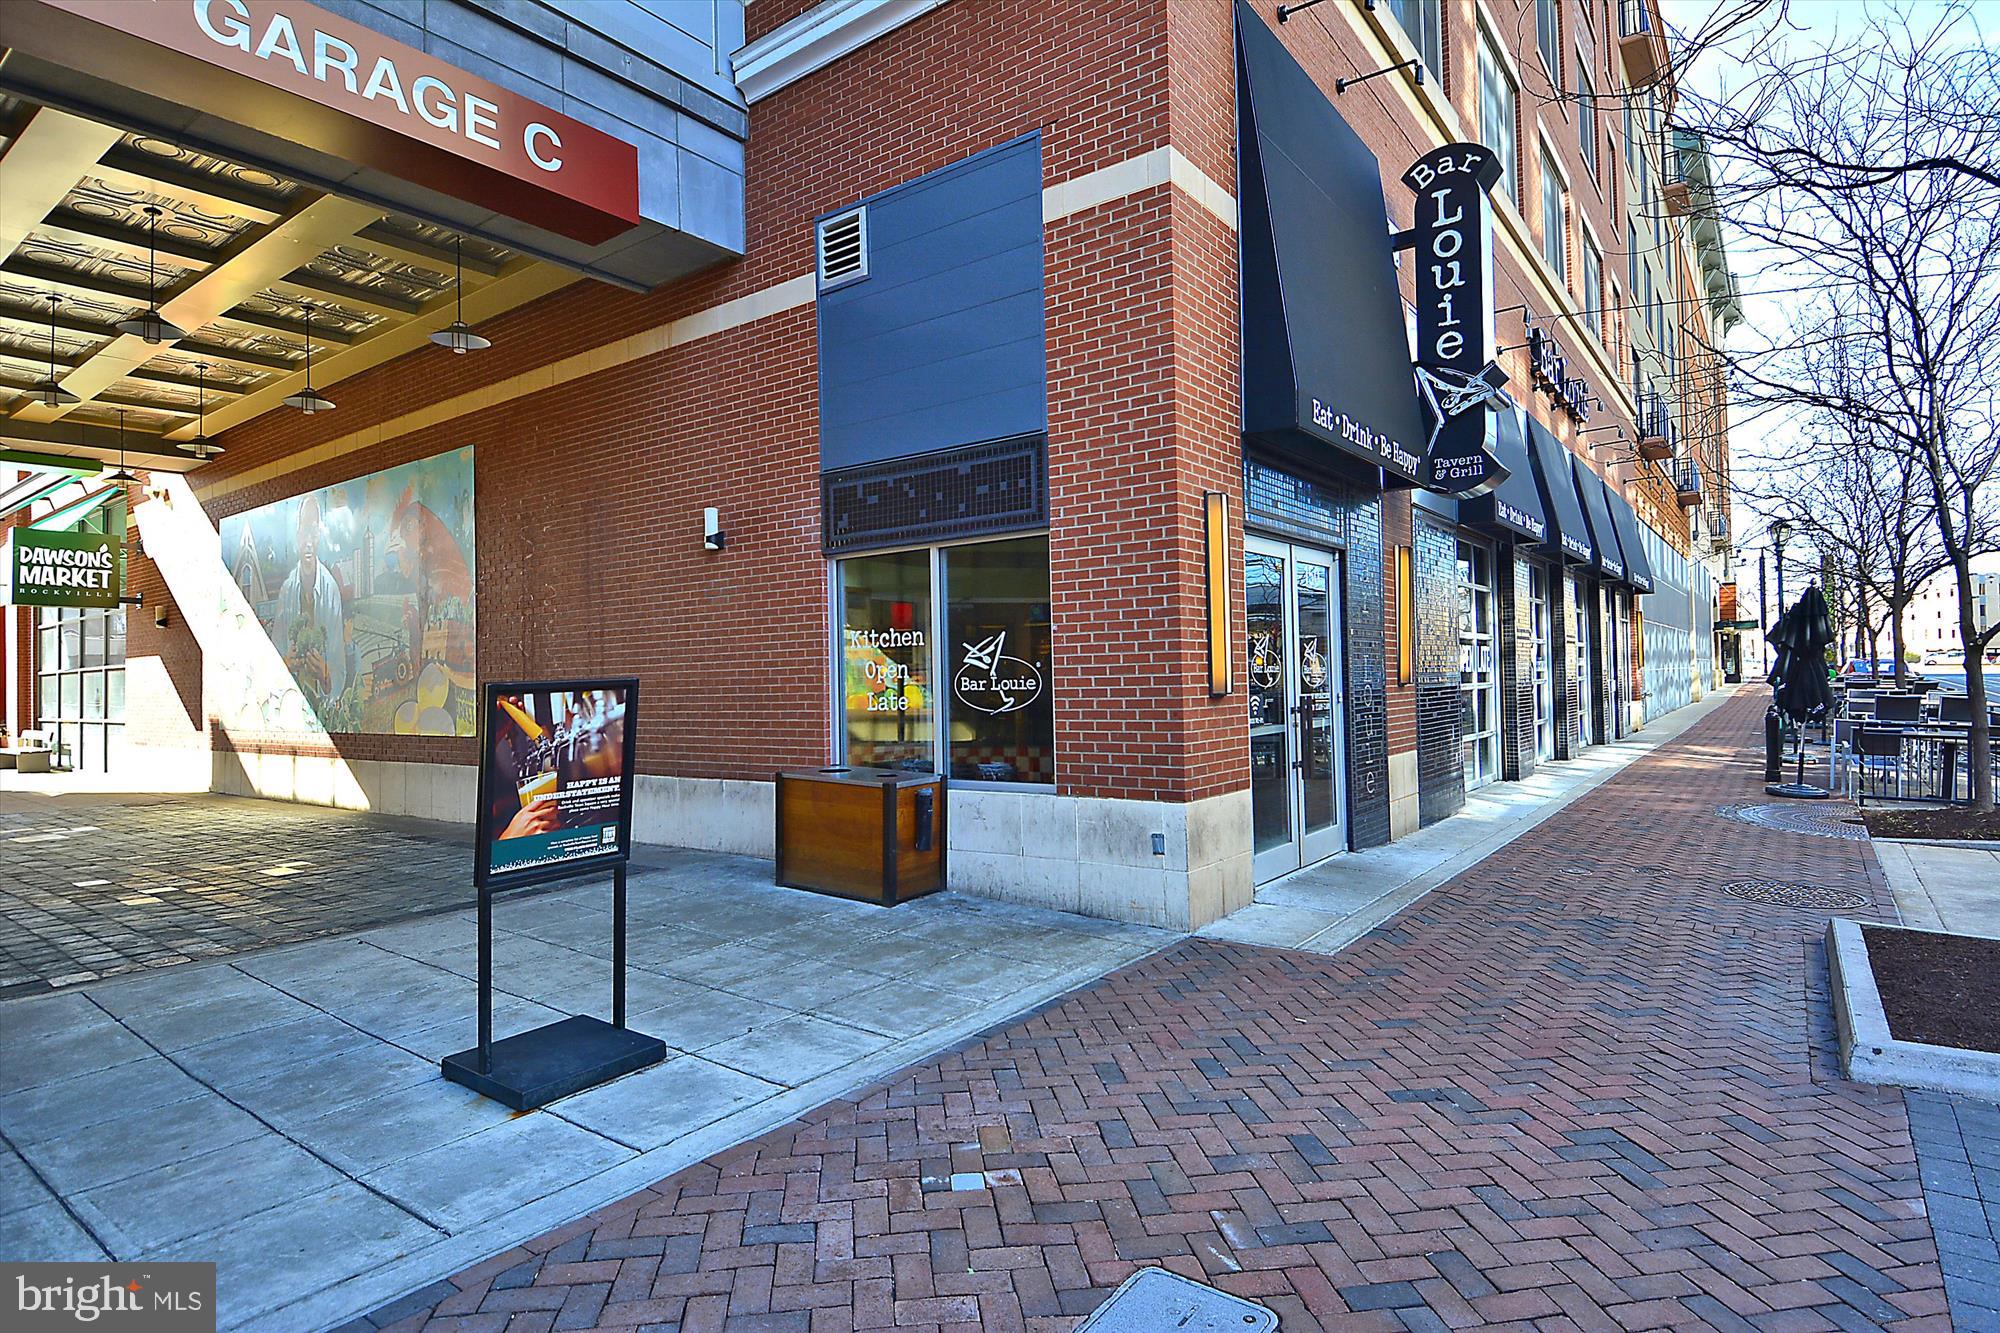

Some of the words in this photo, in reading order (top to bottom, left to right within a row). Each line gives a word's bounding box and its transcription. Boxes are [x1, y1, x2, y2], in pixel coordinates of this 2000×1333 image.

[193, 0, 501, 151] GARAGE
[523, 122, 563, 172] C
[1409, 153, 1482, 190] Bar
[1431, 188, 1466, 360] Louie
[1312, 398, 1334, 431] Eat
[1341, 414, 1374, 451] Drink
[1380, 434, 1392, 459] Be
[1392, 441, 1419, 476] Happy
[1434, 454, 1484, 469] Tavern
[1434, 468, 1447, 480] &
[1450, 464, 1484, 478] Grill
[19, 543, 113, 569] DAWSON'S
[19, 565, 113, 589] MARKET
[19, 588, 113, 598] ROCKVILLE
[850, 627, 925, 649] Kitchen
[864, 660, 909, 685] Open
[960, 676, 987, 692] Bar
[990, 676, 1037, 692] Louie
[867, 693, 909, 712] Late
[533, 784, 621, 802] UNDERSTATEMENT.
[566, 778, 598, 790] HAPPY
[598, 777, 608, 786] IS
[608, 776, 622, 784] AN
